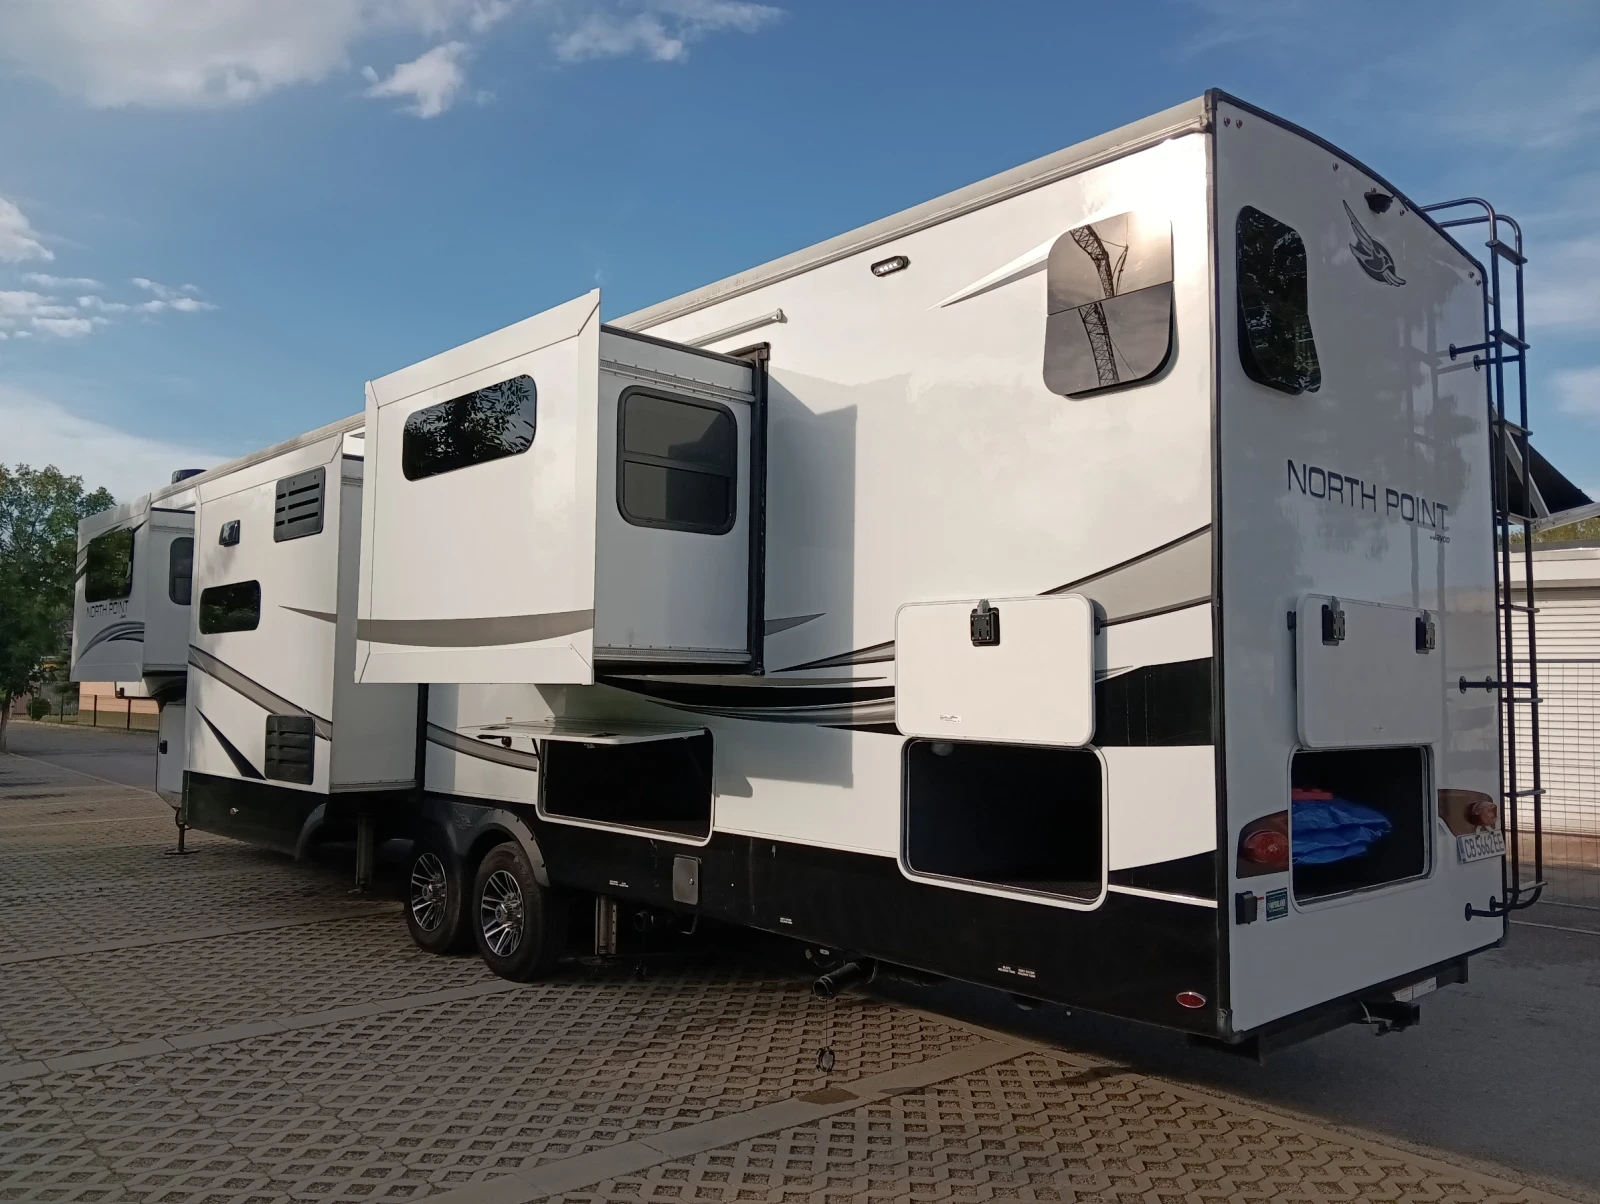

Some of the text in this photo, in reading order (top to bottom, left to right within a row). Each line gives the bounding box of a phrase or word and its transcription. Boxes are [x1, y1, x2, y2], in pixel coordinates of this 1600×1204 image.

[1287, 459, 1449, 530] NORTH POINT
[86, 600, 129, 618] NORTH POINT
